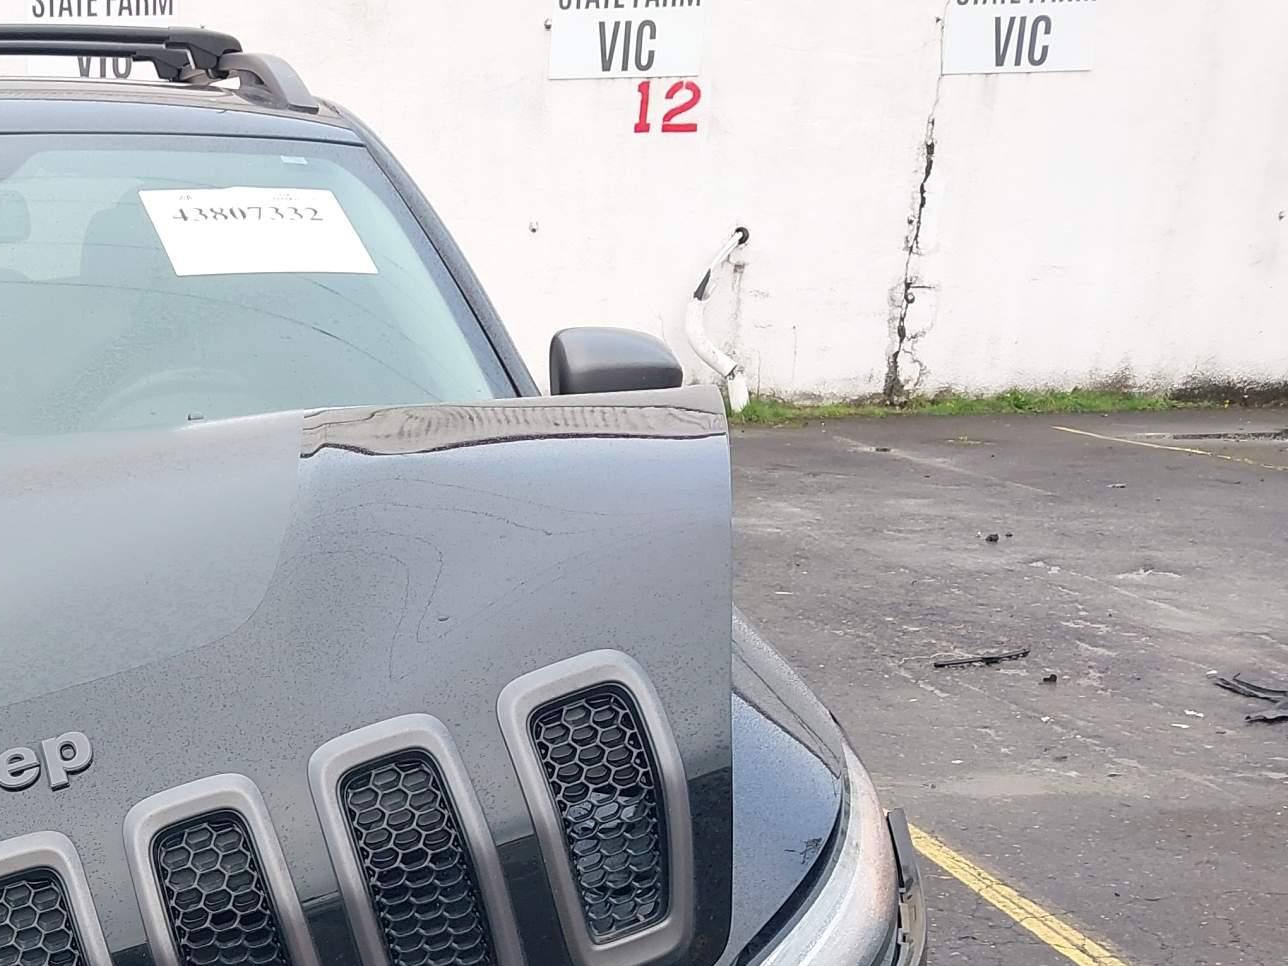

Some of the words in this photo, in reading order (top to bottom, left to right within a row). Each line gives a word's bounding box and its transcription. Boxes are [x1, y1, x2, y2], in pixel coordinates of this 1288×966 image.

[598, 20, 657, 72] VIC
[994, 14, 1052, 67] VIC
[633, 80, 702, 133] 12
[172, 205, 325, 222] 43807332
